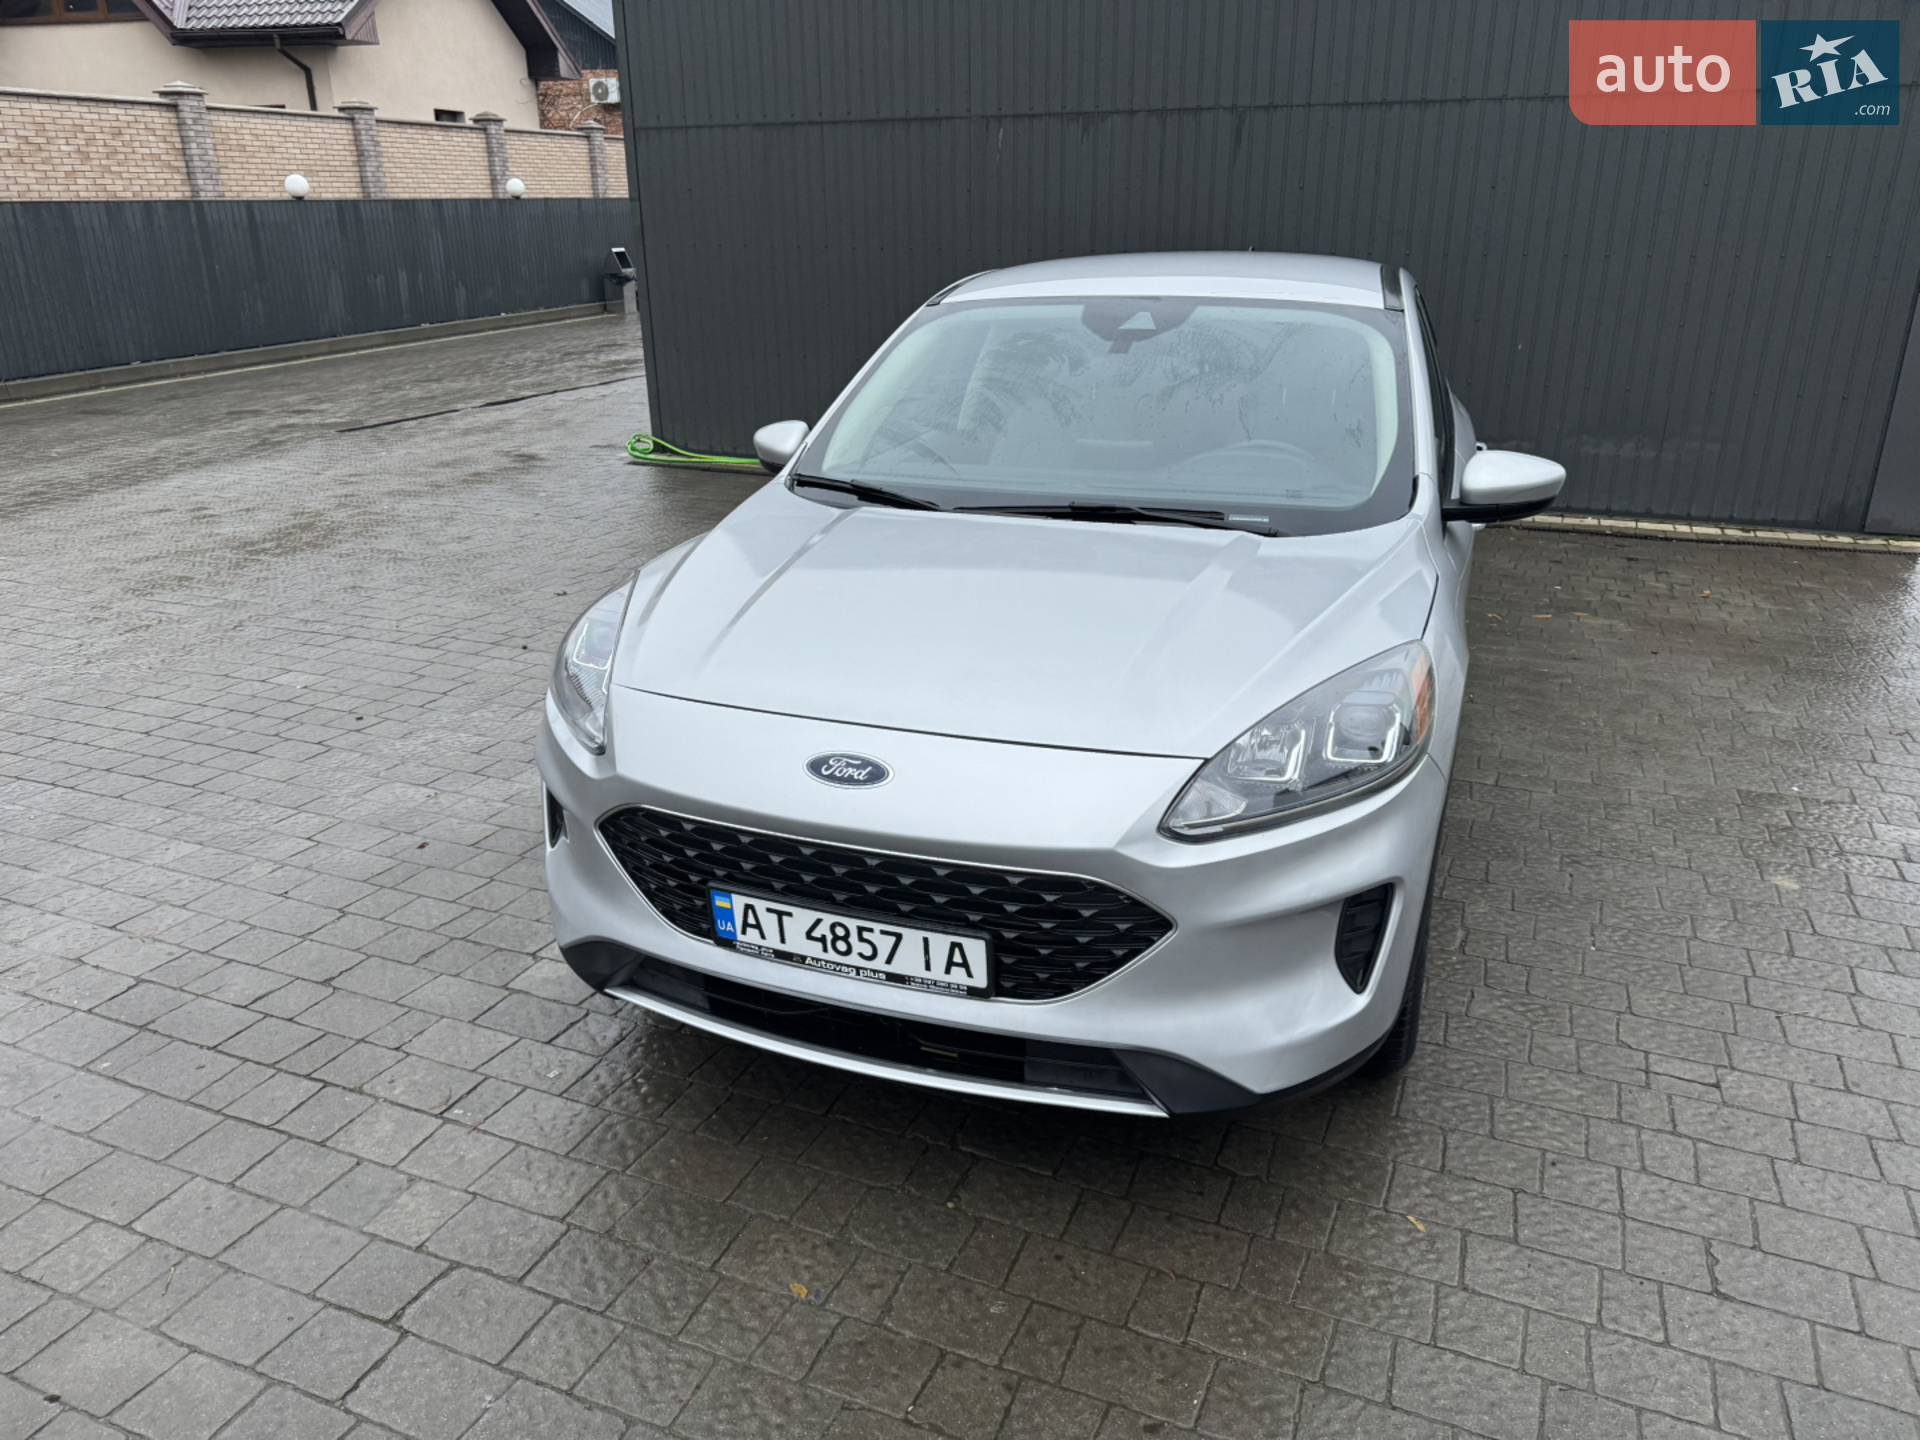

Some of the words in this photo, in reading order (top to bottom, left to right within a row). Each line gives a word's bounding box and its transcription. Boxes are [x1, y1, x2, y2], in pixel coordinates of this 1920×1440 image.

[821, 756, 873, 781] Ford
[717, 919, 735, 933] UA
[740, 903, 794, 945] AT
[805, 918, 903, 965] 4857
[921, 936, 975, 979] IA
[805, 956, 857, 977] Autovag
[859, 969, 886, 980] plus
